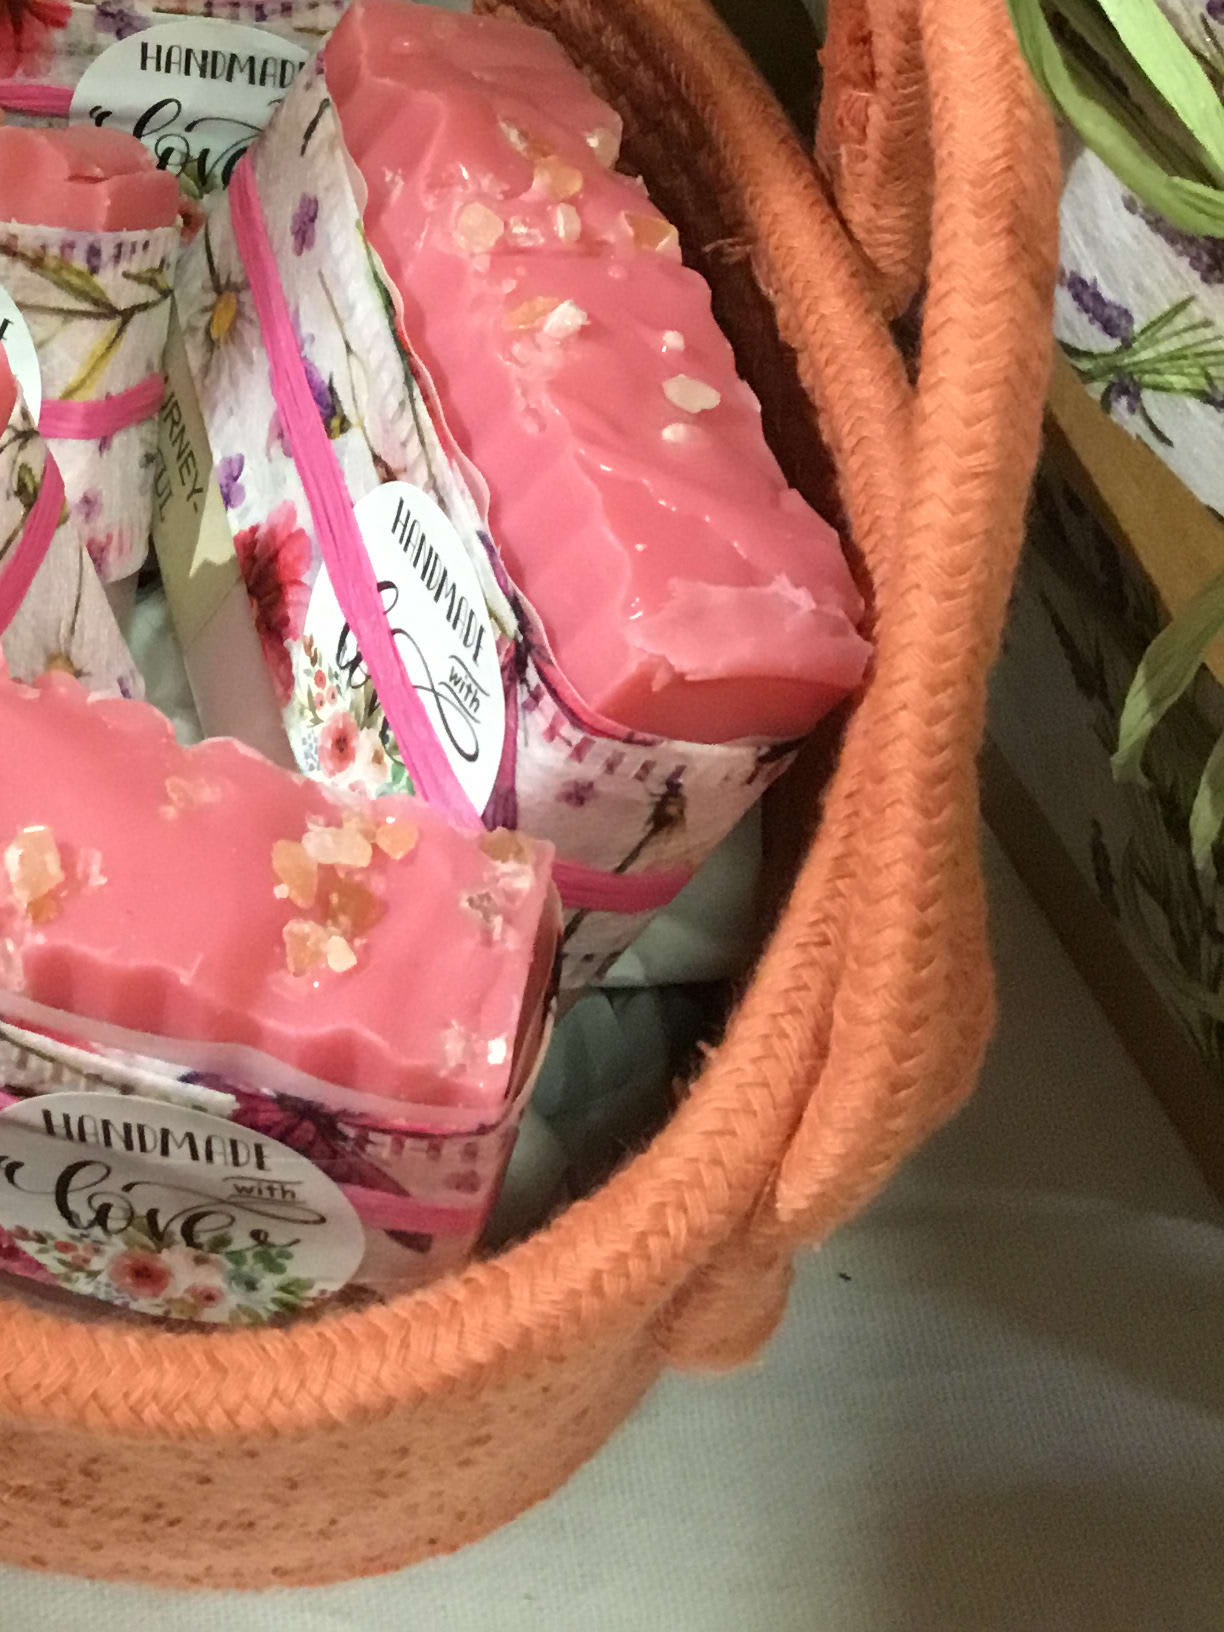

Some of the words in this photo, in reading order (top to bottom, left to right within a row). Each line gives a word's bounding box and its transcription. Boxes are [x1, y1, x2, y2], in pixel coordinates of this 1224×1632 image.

[140, 41, 305, 89] HANDMAD
[391, 496, 487, 666] HANDMADE
[446, 665, 481, 714] with
[41, 1109, 274, 1171] HANDMADE
[233, 1180, 297, 1200] with
